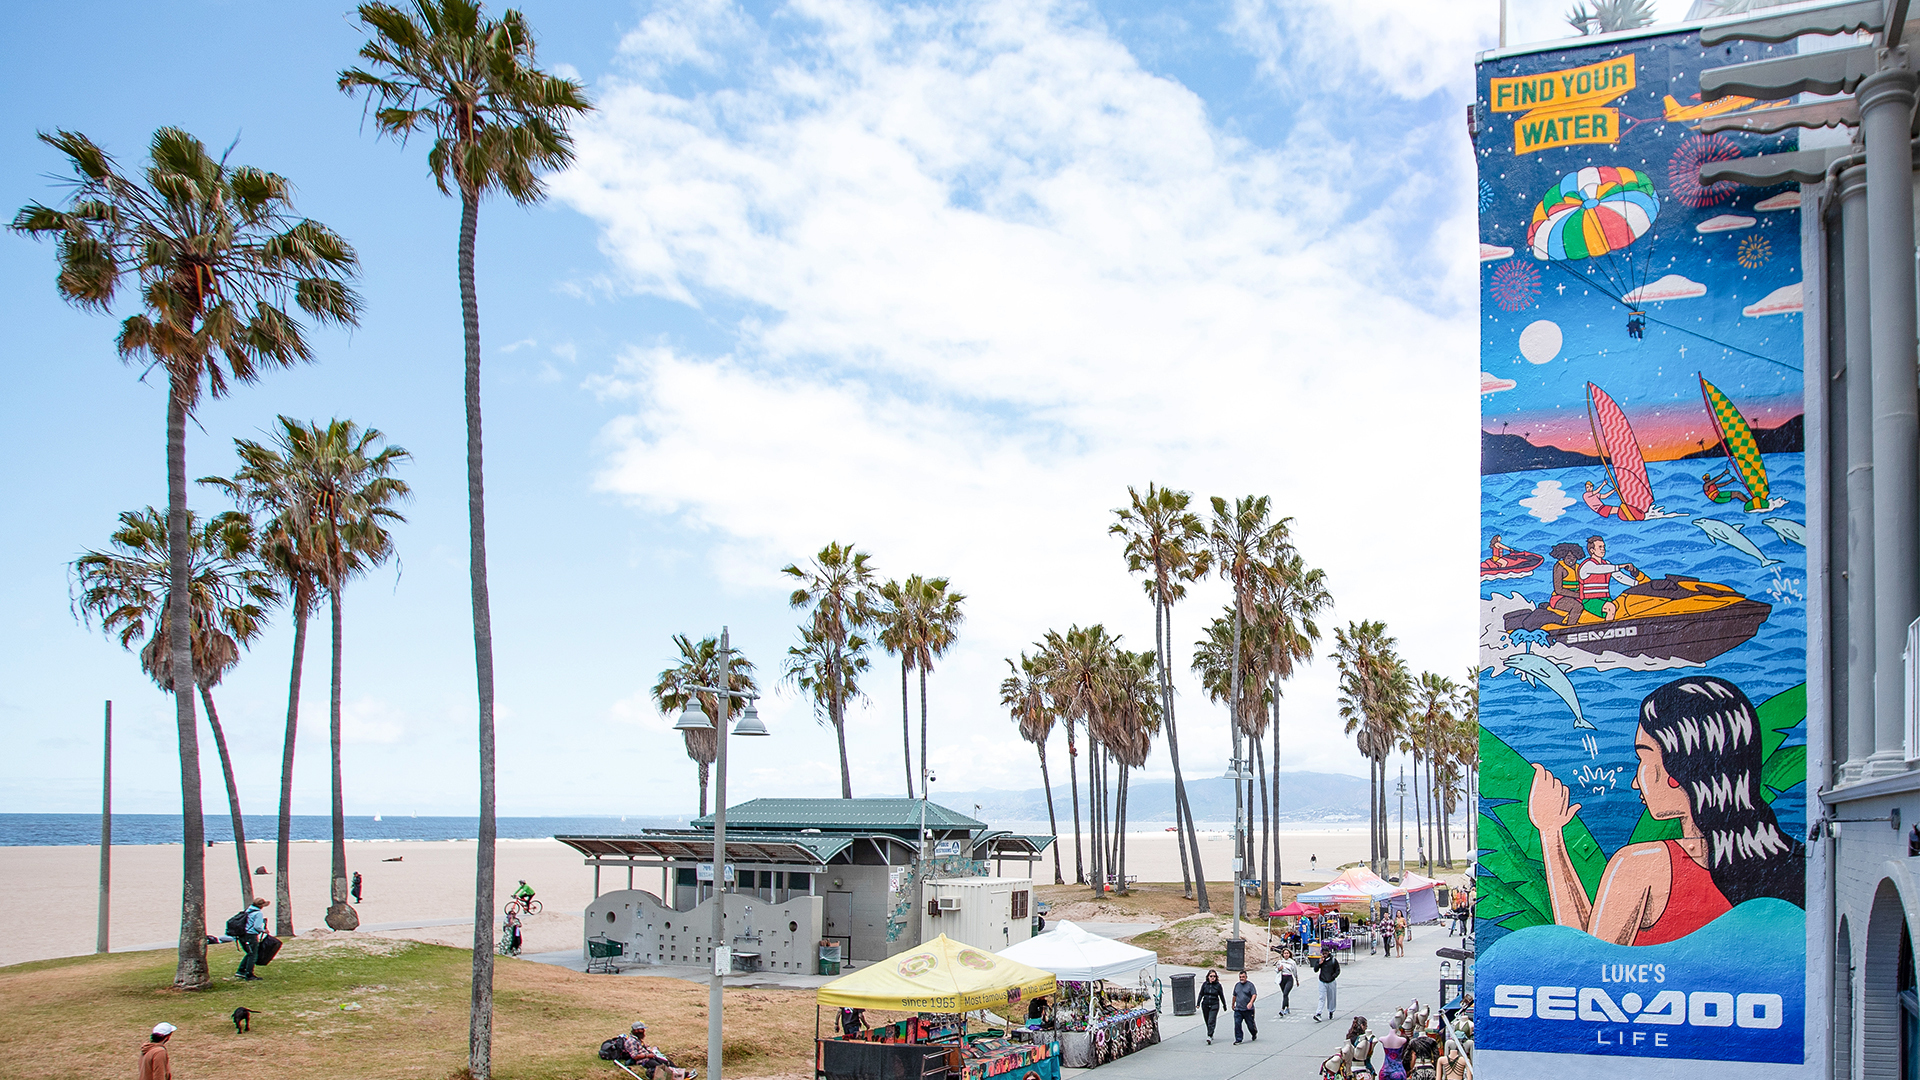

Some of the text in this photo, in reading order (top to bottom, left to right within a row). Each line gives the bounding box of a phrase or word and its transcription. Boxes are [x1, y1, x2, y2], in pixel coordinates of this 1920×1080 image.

[1497, 63, 1627, 107] FIND YOUR
[1522, 113, 1608, 147] WATER
[1602, 963, 1666, 984] LUKE'S
[901, 996, 956, 1009] since 1965
[964, 996, 982, 1006] Most
[982, 992, 1007, 1004] famous
[1022, 986, 1028, 994] in
[1028, 985, 1038, 994] the
[1598, 1030, 1669, 1047] LIFE
